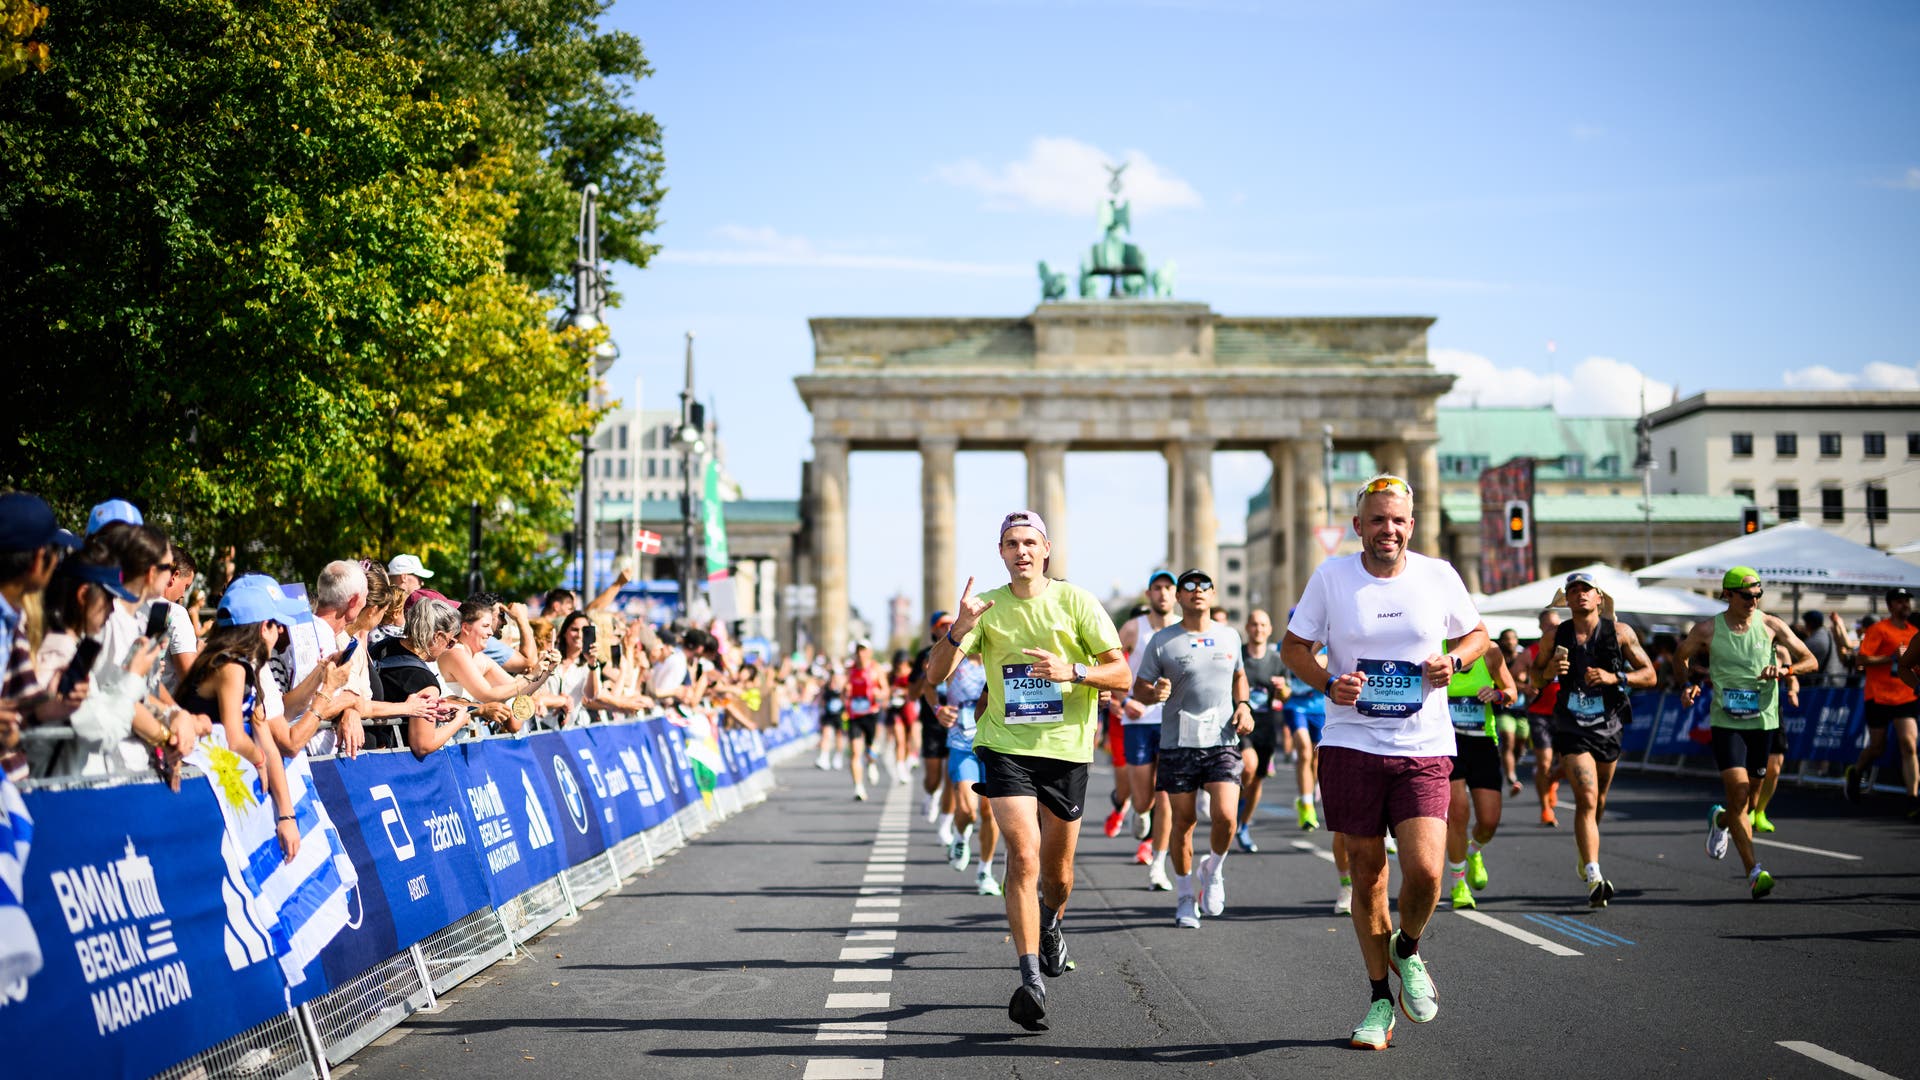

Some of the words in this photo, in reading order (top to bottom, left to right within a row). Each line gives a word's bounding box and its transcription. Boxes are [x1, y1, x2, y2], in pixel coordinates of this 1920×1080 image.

[1012, 678, 1052, 690] 24306
[1367, 676, 1412, 689] 65993
[1374, 688, 1404, 697] Siegfried
[1018, 701, 1049, 711] zalando
[1371, 702, 1406, 712] zalando
[467, 785, 495, 822] BMW
[423, 807, 466, 852] zalando
[50, 862, 128, 935] BMW
[406, 874, 430, 902] ABBOTT
[75, 923, 147, 983] BERLIN
[90, 960, 192, 1036] MARATHON
